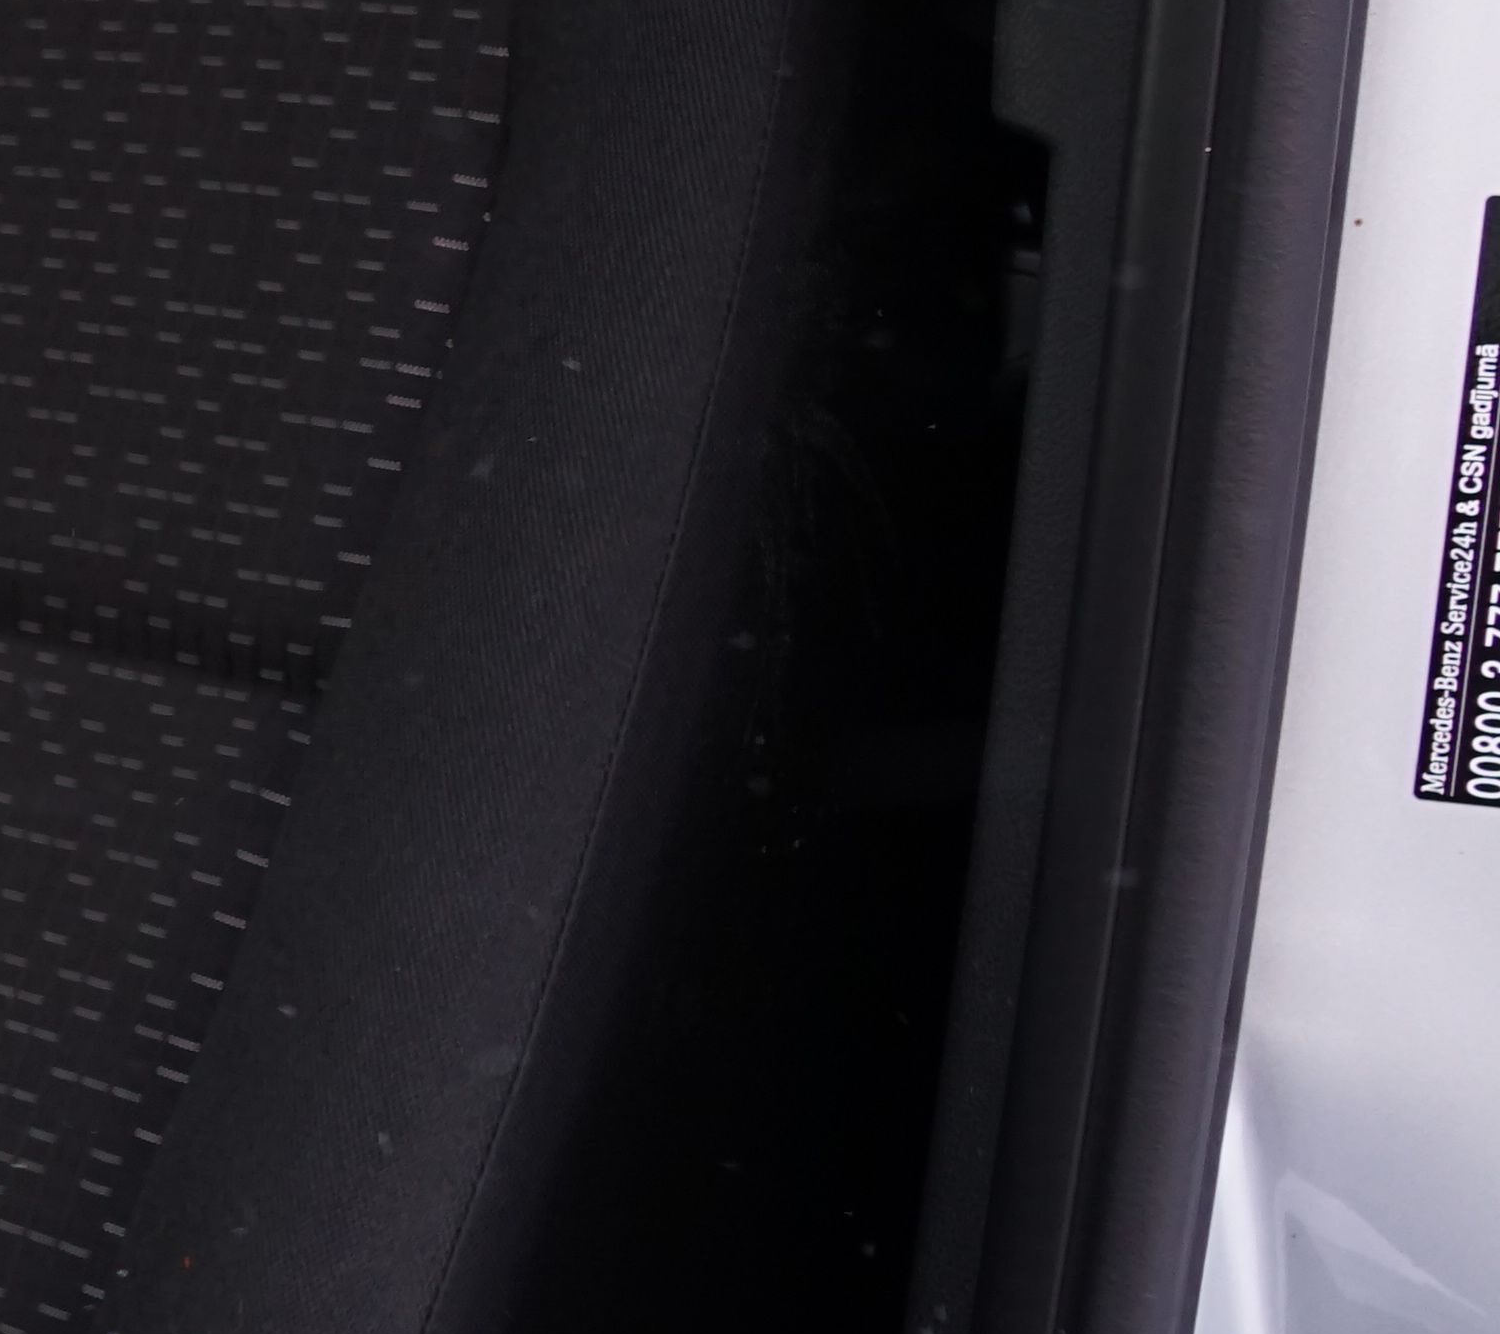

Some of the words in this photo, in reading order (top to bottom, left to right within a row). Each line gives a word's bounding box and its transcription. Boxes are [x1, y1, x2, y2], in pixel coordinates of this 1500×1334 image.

[1469, 343, 1500, 439] gadījumā
[1456, 499, 1480, 517] &
[1458, 443, 1487, 495] CSN
[1440, 521, 1478, 635] Service24h
[1420, 640, 1464, 796] Mercedes-Benz
